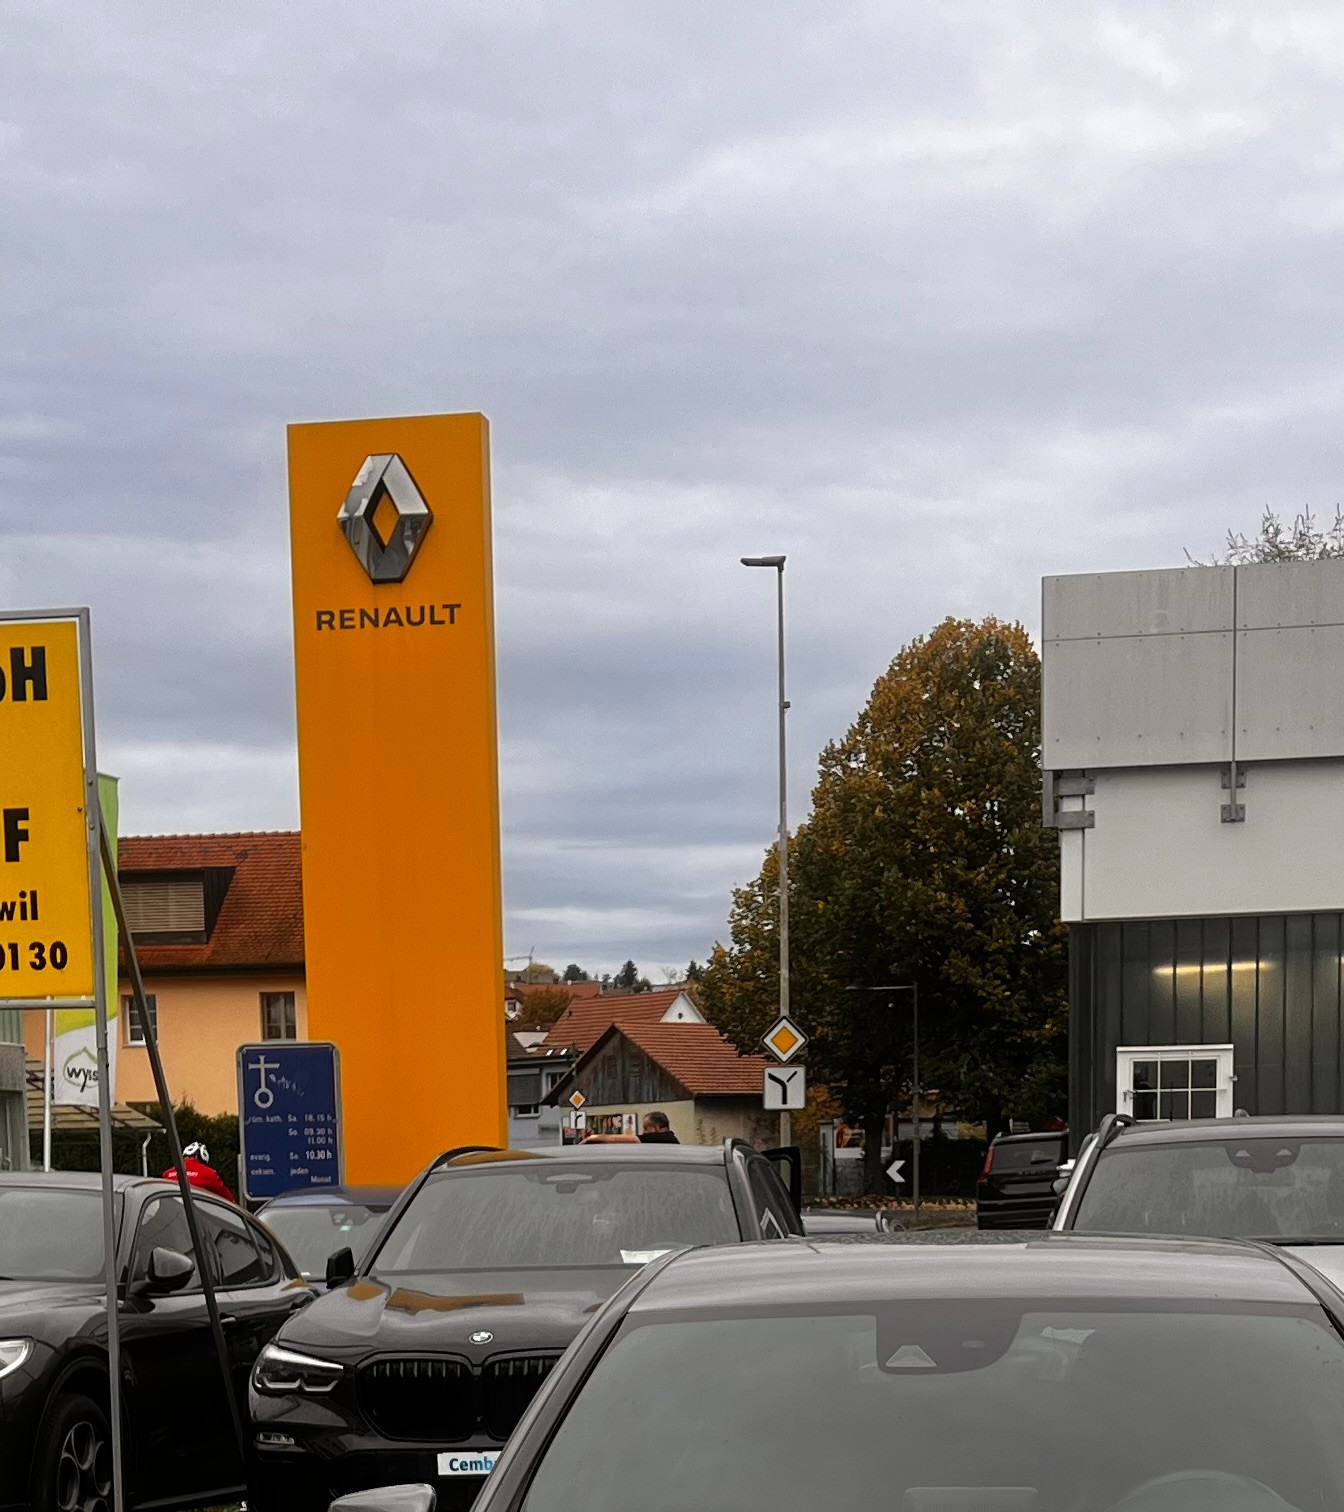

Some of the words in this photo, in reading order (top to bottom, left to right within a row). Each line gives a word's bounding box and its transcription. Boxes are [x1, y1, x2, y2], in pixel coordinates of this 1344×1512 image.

[316, 603, 462, 631] RENAULT
[305, 1150, 326, 1160] 10.30
[449, 1456, 495, 1471] Cemb
